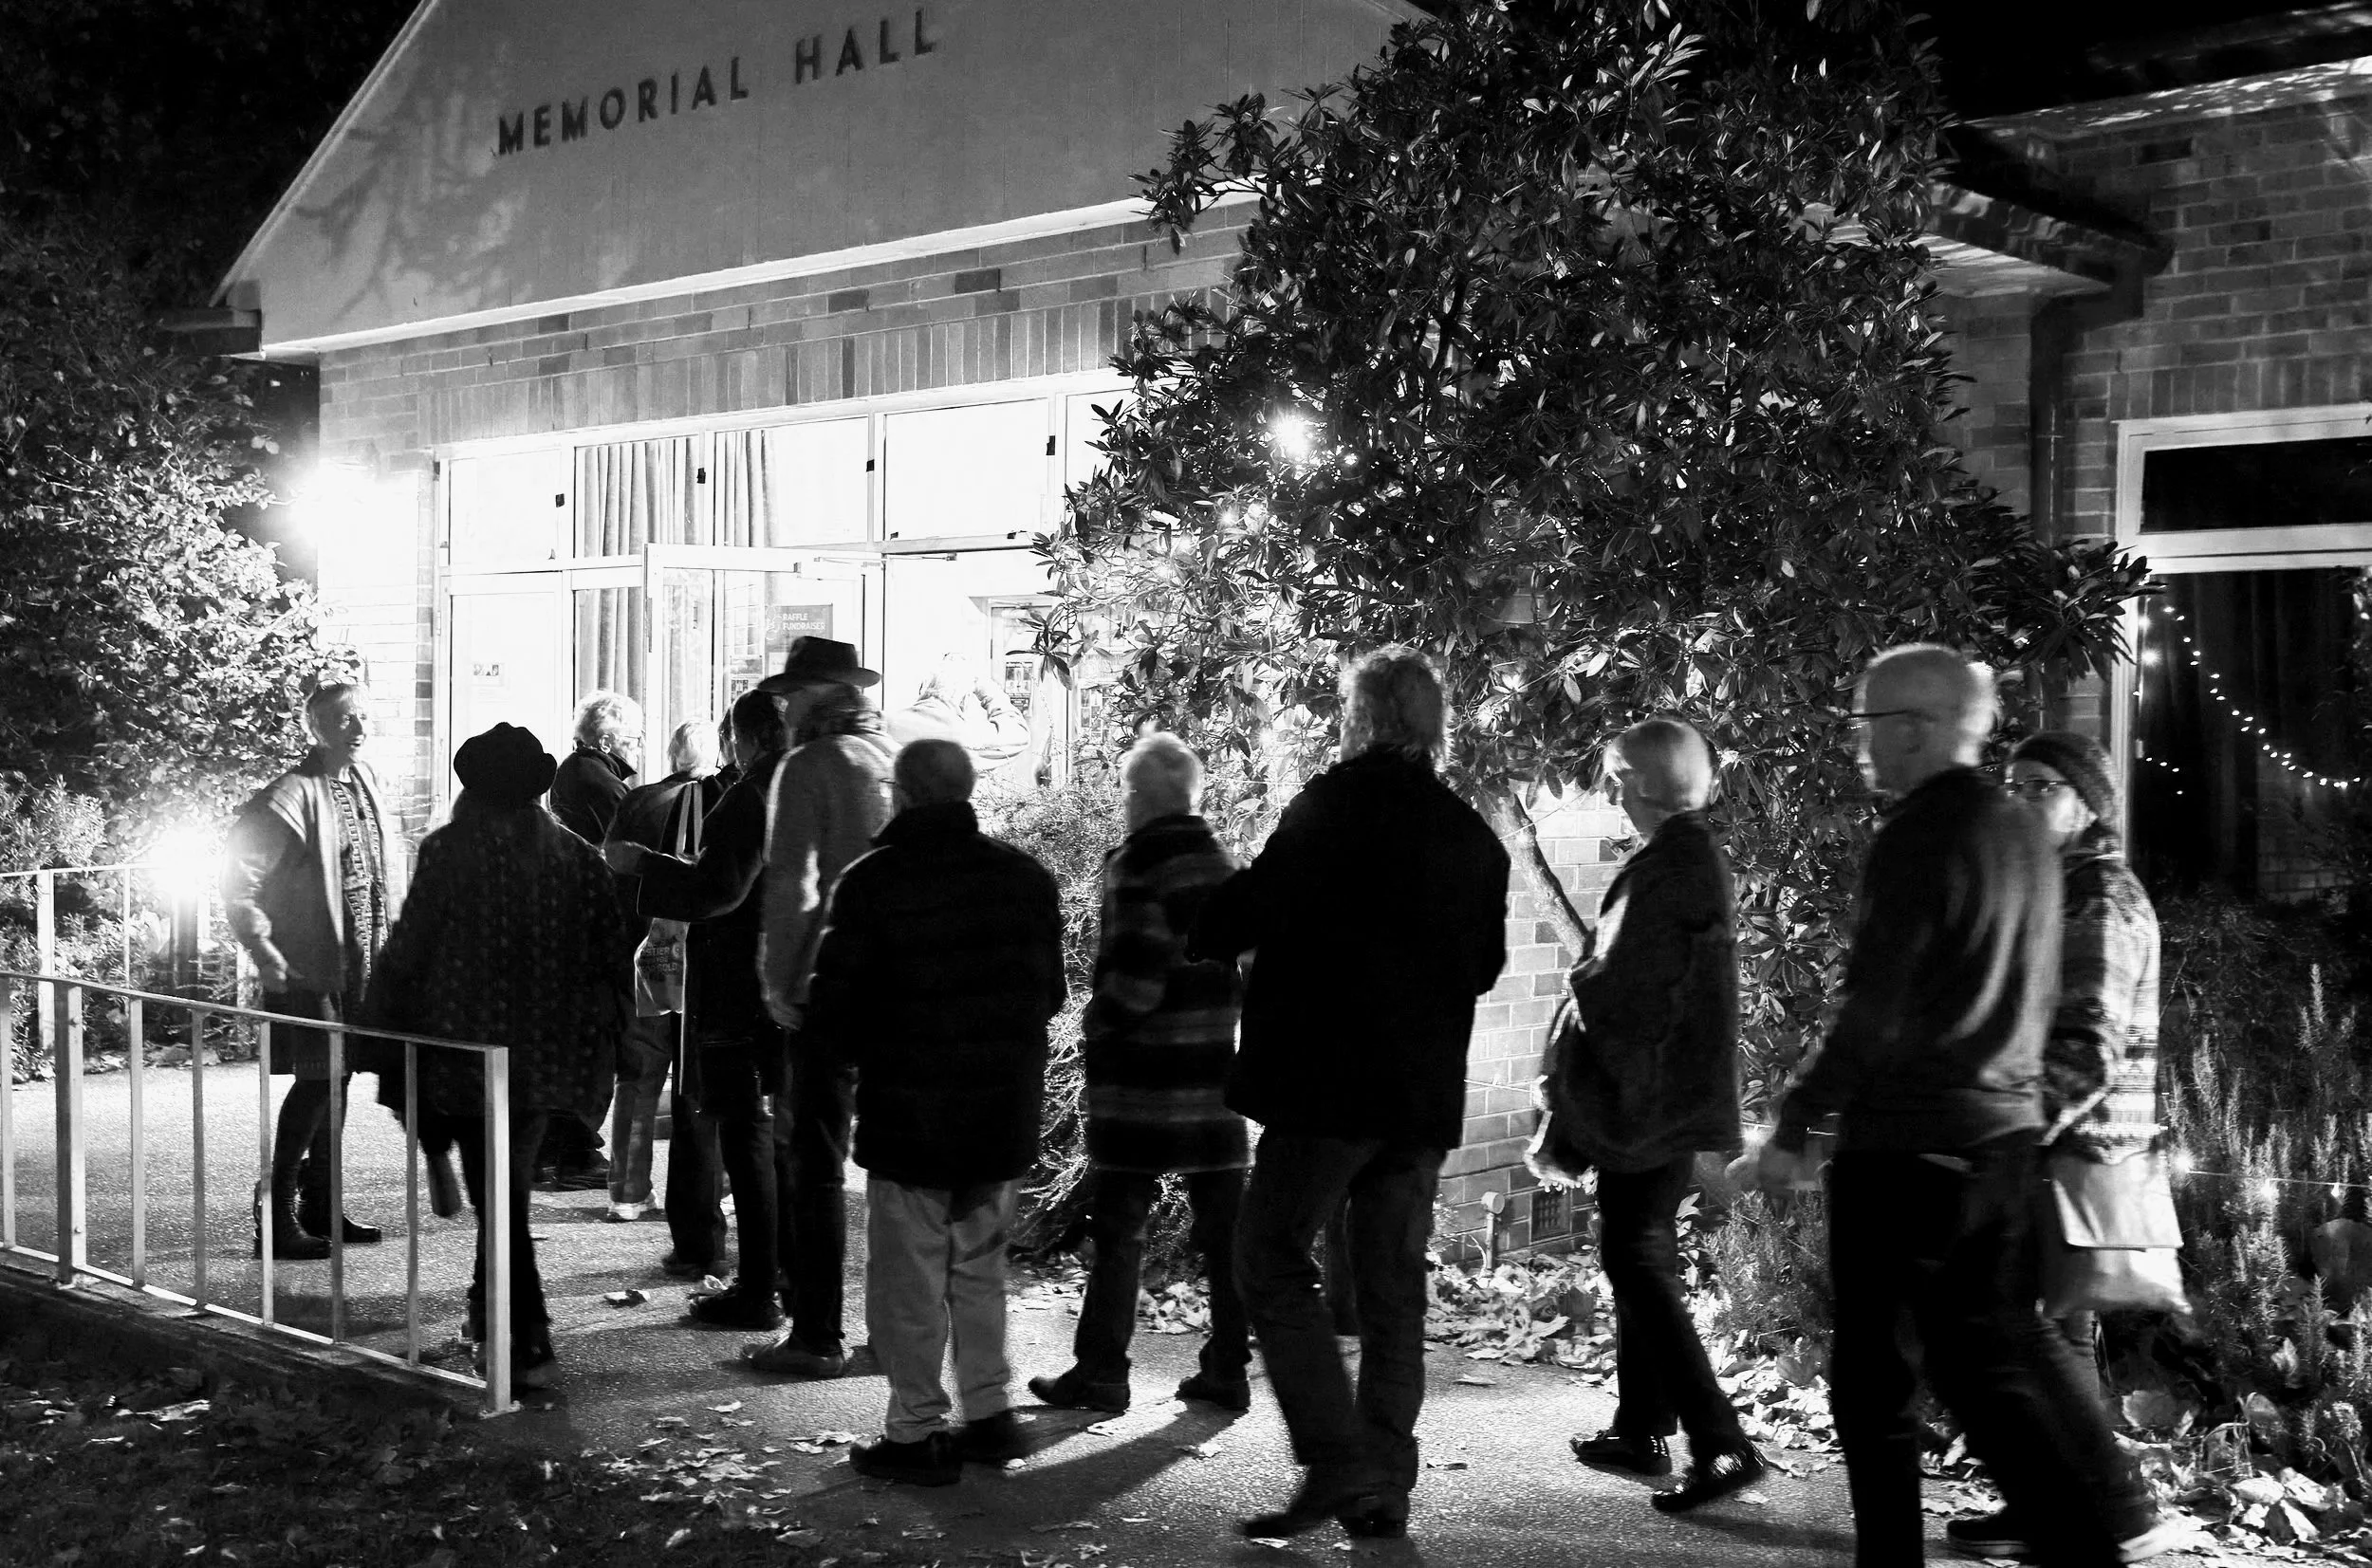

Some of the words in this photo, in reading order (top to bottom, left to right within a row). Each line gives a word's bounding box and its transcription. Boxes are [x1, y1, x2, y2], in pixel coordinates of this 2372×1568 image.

[498, 57, 750, 156] MEMORIAL
[795, 9, 936, 84] HALL
[783, 613, 808, 621] RAFFLE
[783, 622, 825, 631] FUNDRAISER
